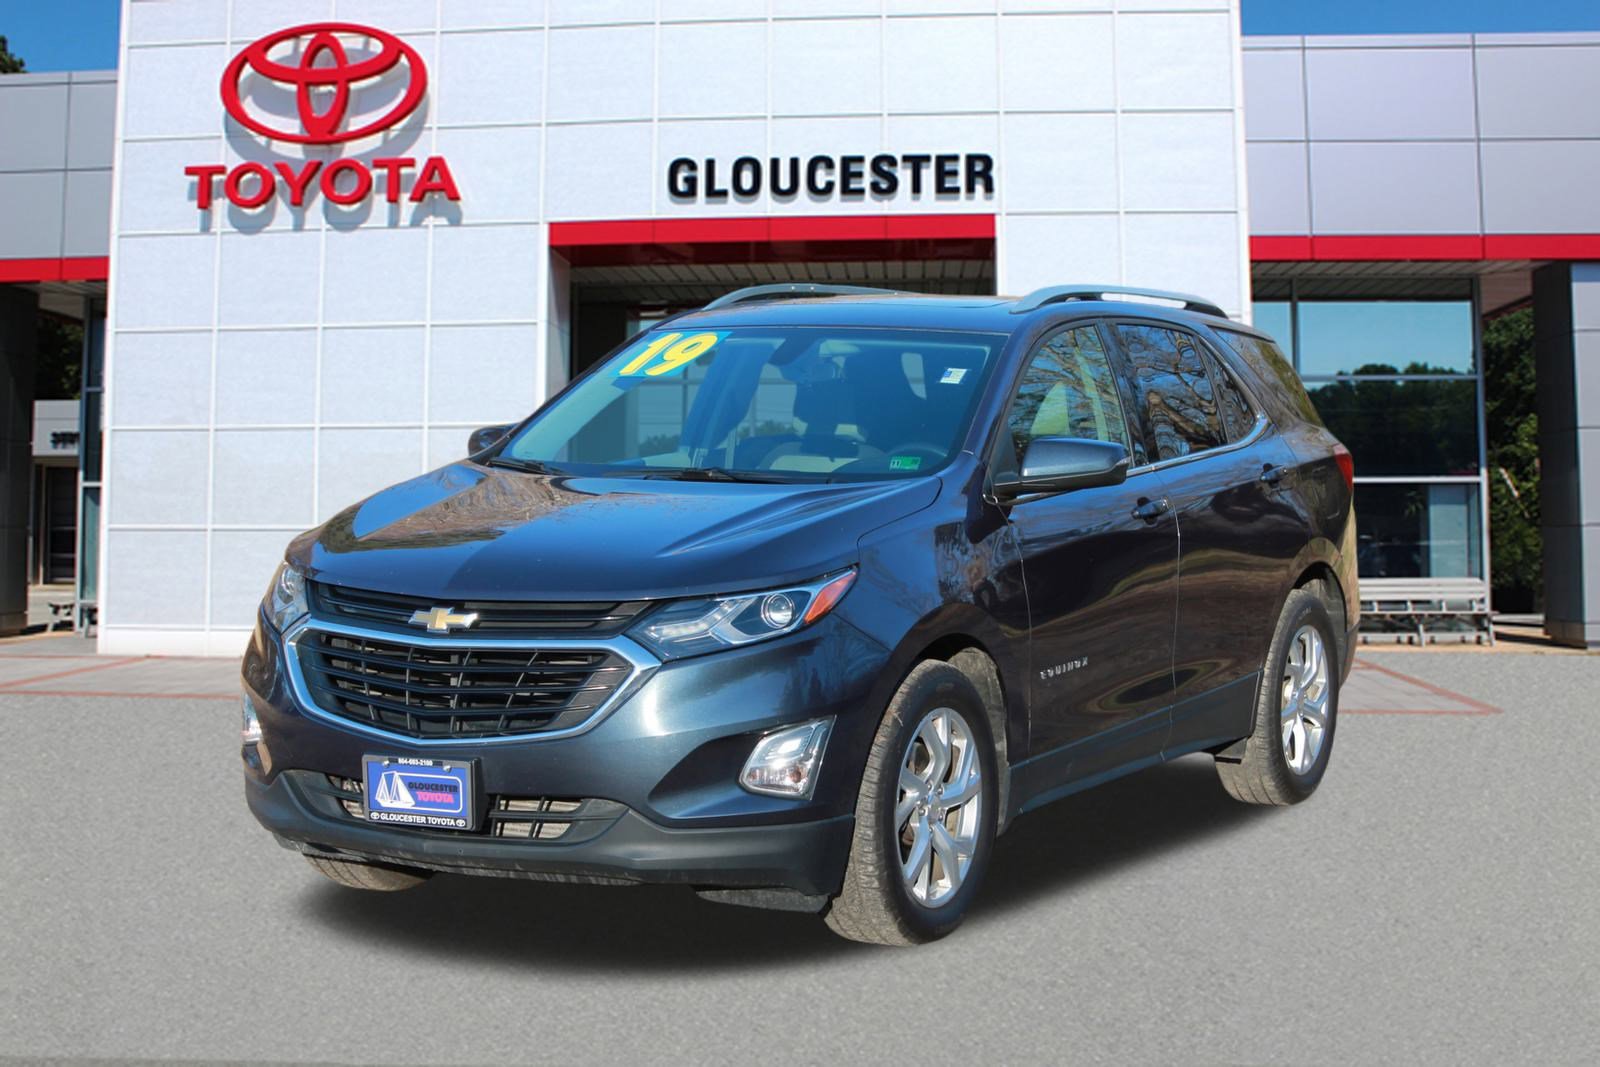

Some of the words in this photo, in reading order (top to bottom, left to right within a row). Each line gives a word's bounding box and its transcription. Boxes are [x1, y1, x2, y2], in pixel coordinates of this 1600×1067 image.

[185, 156, 461, 210] TOYOTA
[667, 153, 994, 198] GLOUCESTER
[619, 332, 718, 376] 19
[1039, 656, 1088, 680] EQUINOX
[408, 782, 458, 792] GLOUCESTER
[416, 791, 454, 803] TOYOTA
[380, 812, 426, 824] GLOUCESTER
[428, 816, 456, 827] TOYOTA
